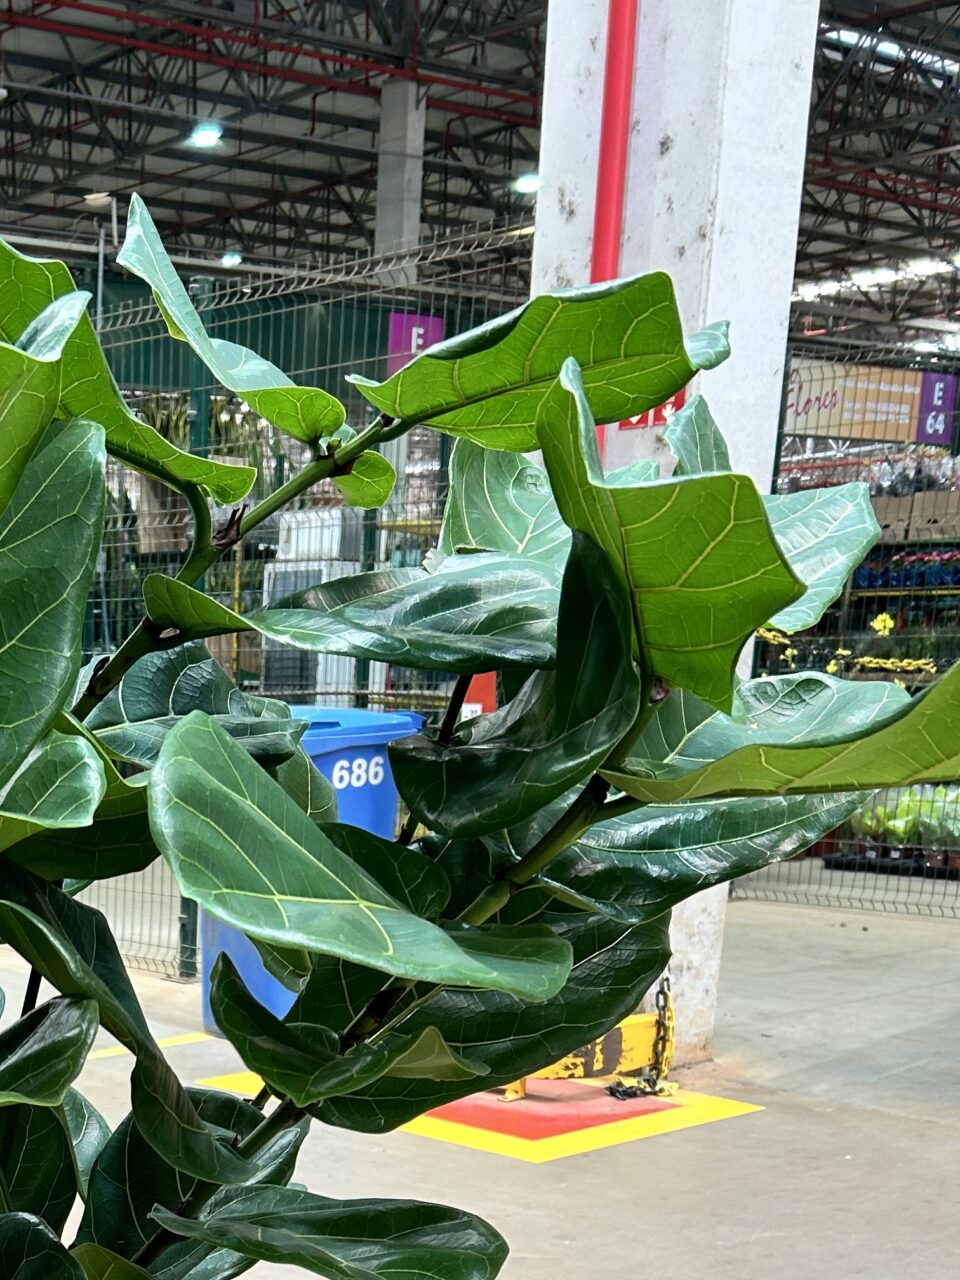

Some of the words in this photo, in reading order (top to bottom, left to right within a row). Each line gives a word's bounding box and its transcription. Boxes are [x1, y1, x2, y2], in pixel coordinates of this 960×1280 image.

[411, 326, 425, 356] E
[933, 382, 945, 406] E
[926, 411, 945, 435] 64
[332, 756, 384, 789] 686
